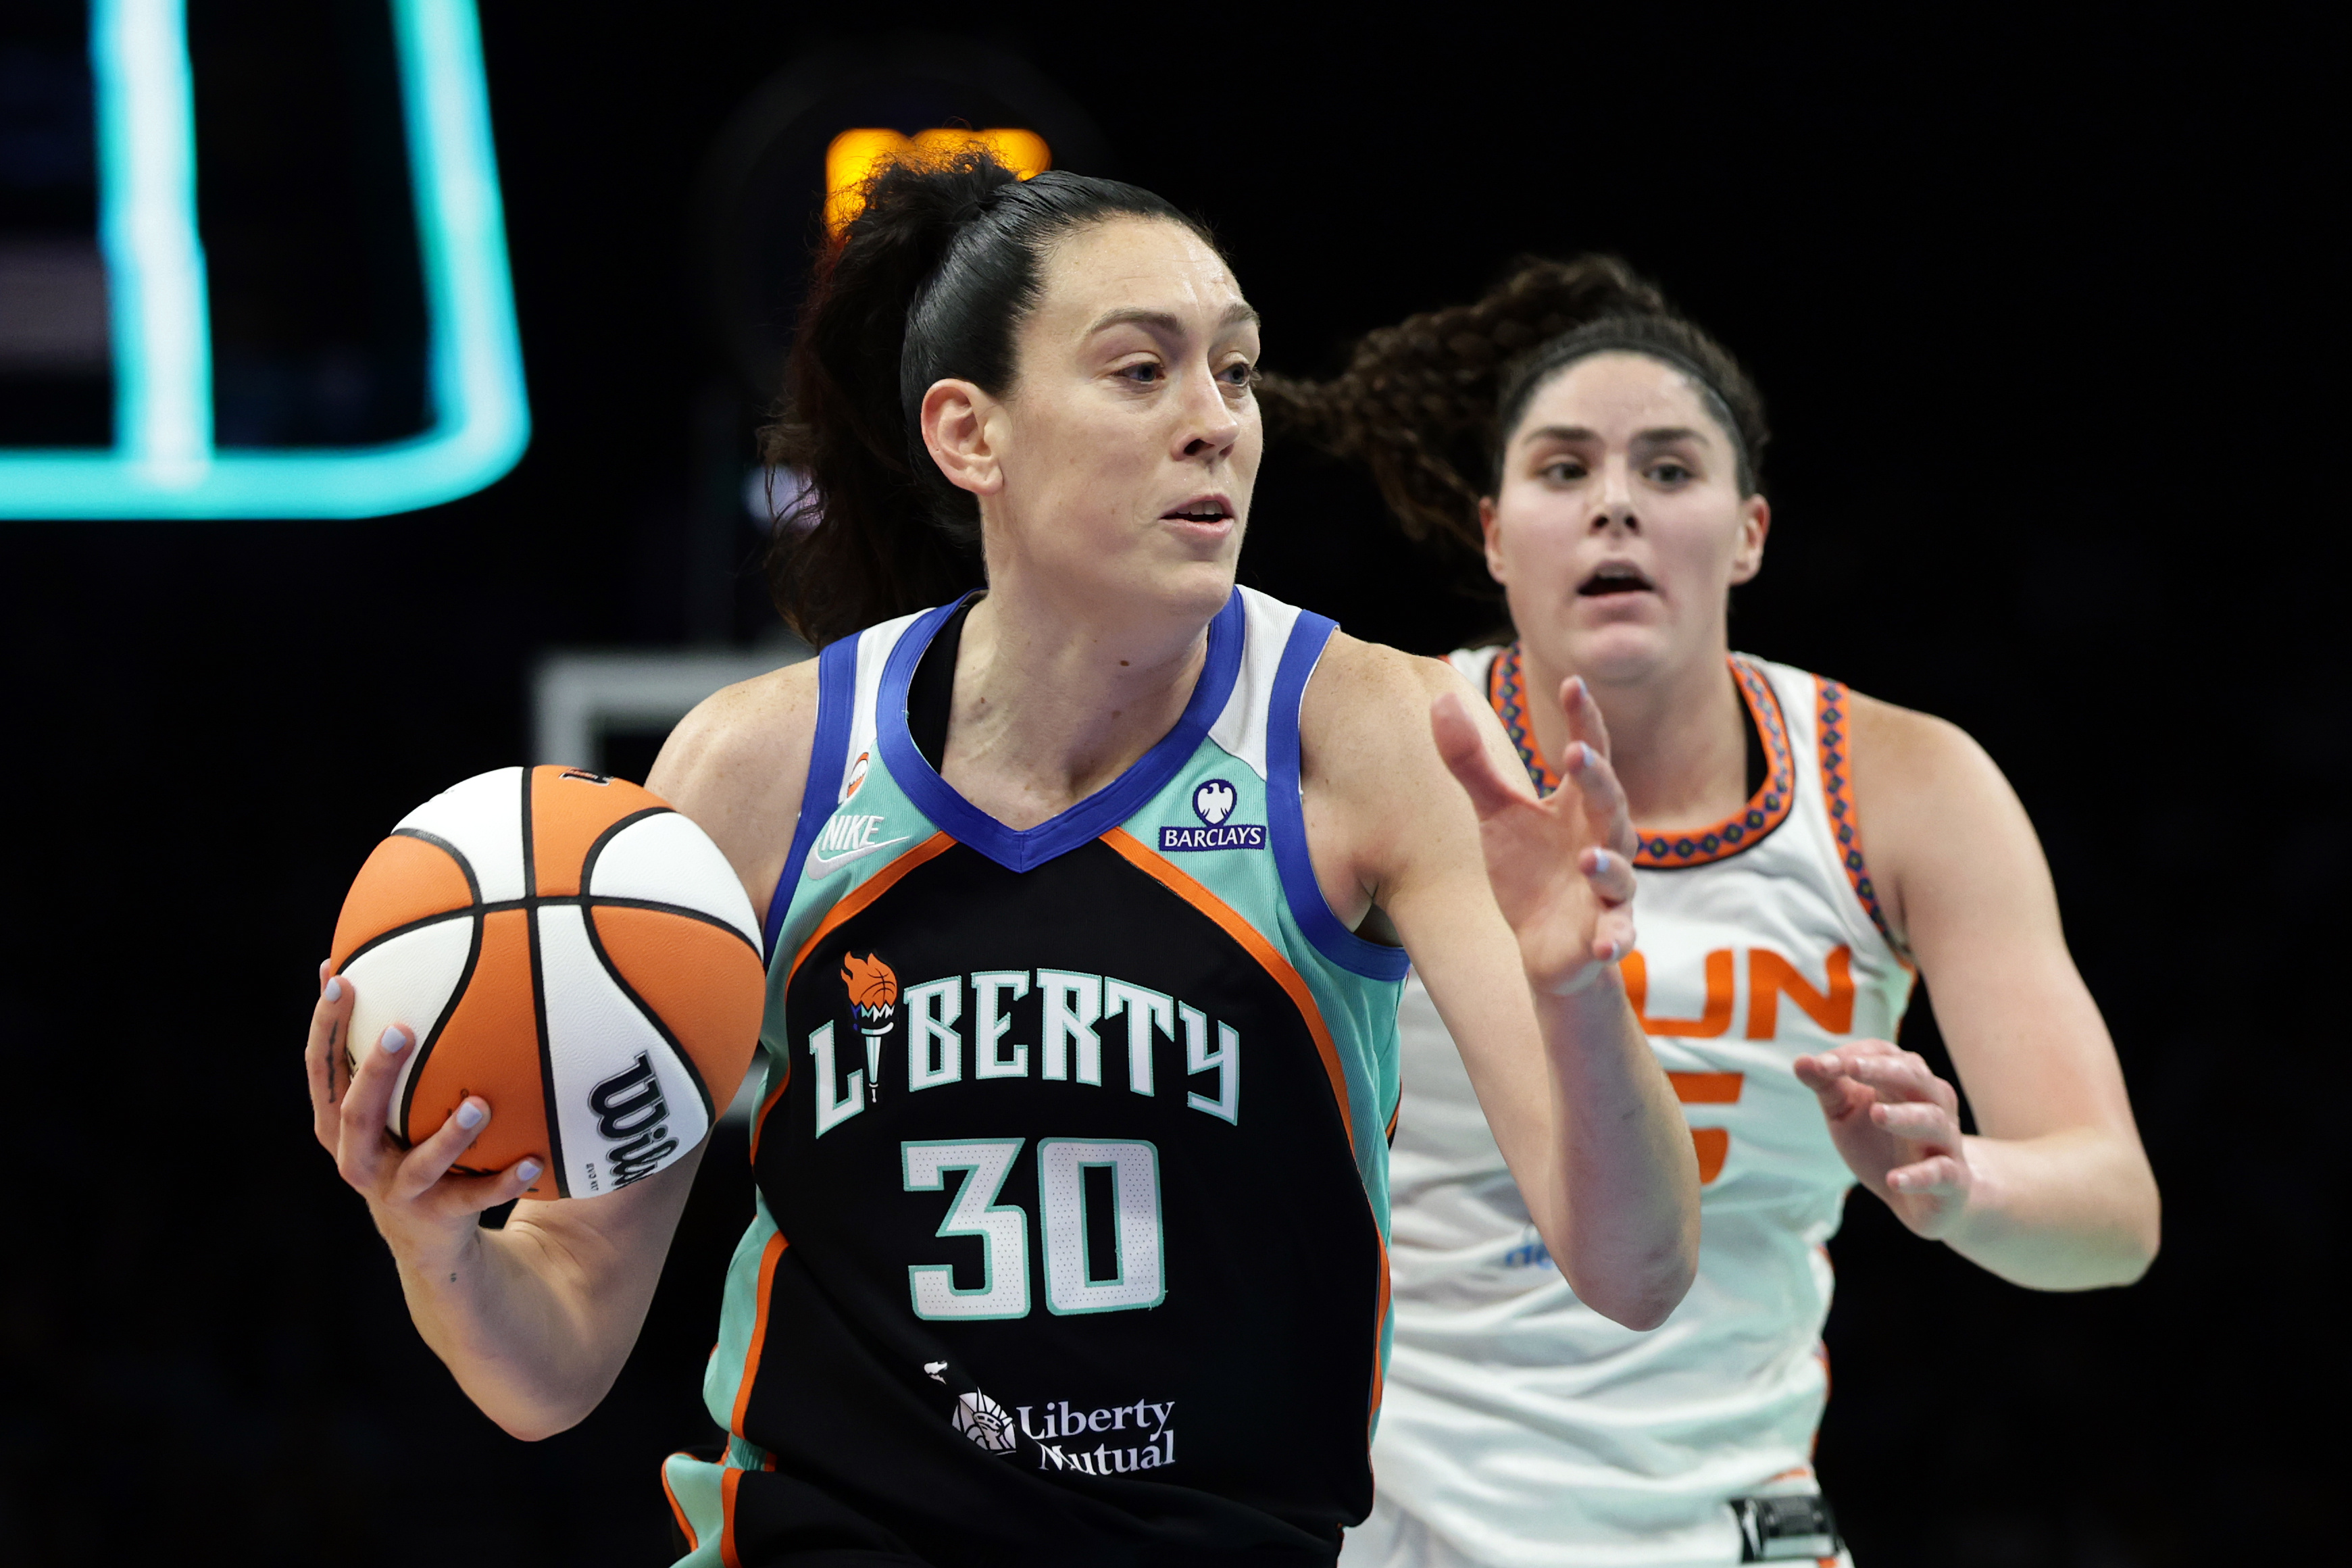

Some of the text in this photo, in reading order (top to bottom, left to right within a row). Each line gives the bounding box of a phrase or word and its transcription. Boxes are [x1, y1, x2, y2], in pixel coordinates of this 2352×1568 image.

[821, 815, 884, 851] NIKE
[1164, 827, 1262, 847] BARCLAYS
[1618, 945, 1855, 1040] UN
[809, 951, 1241, 1140] LIBERTY
[901, 1137, 1167, 1321] 30
[1016, 1398, 1176, 1442] Liberty
